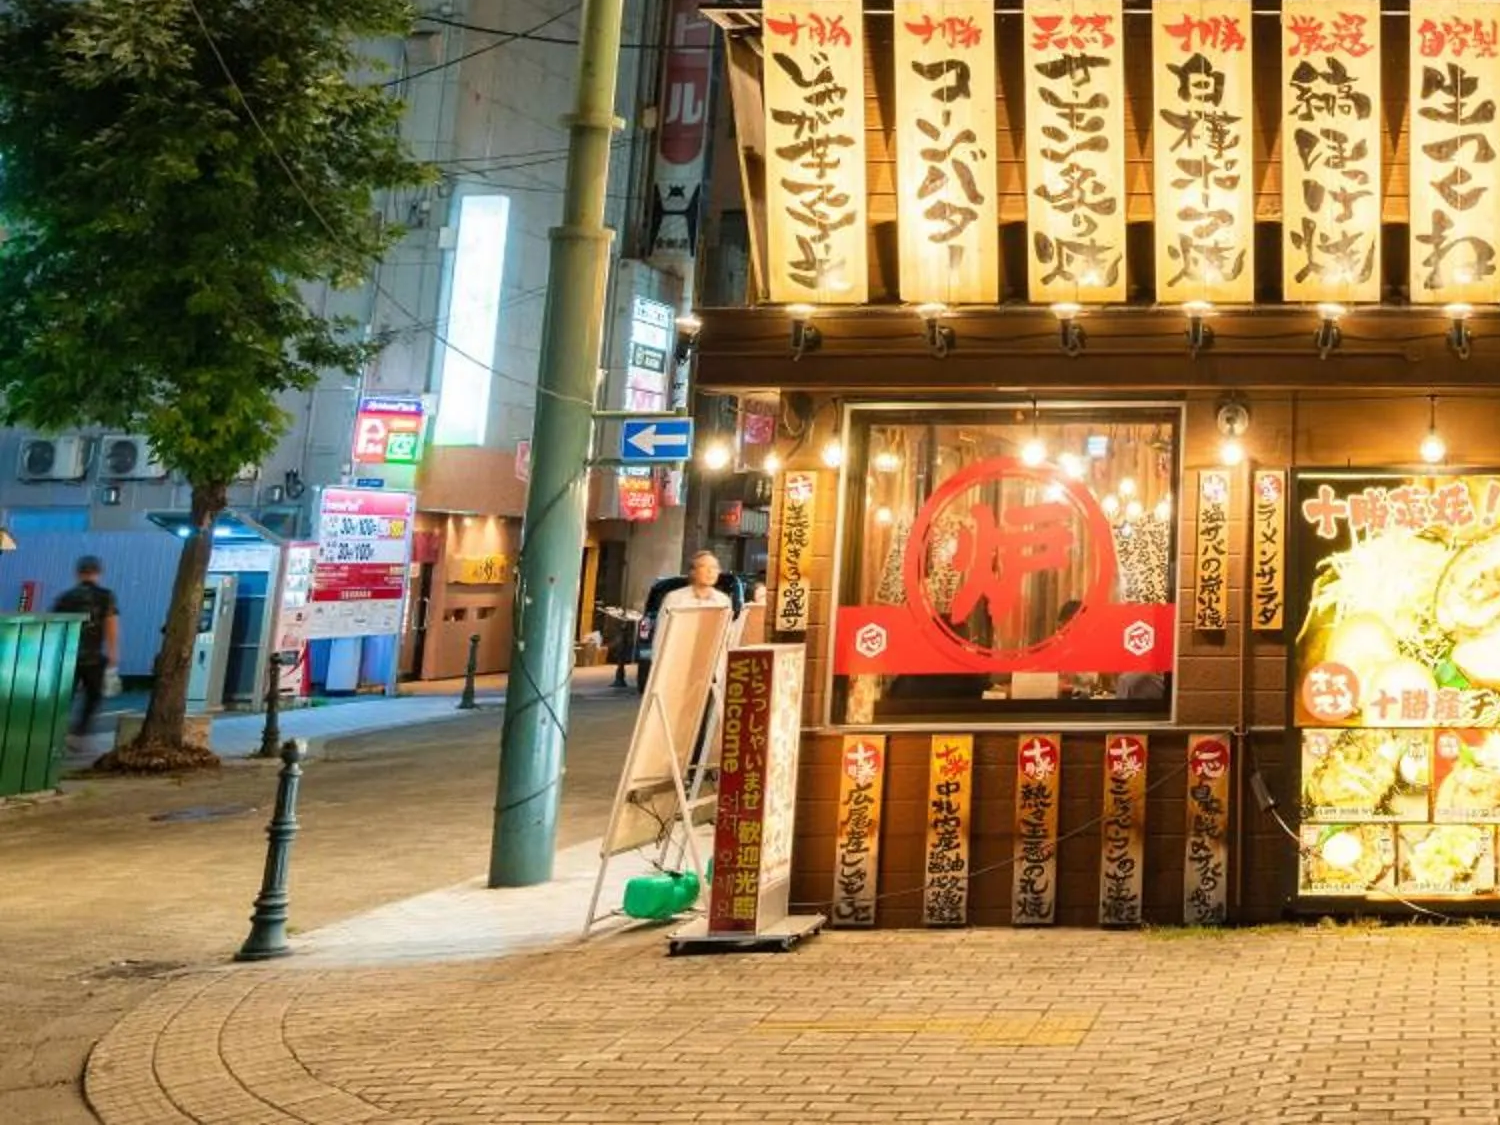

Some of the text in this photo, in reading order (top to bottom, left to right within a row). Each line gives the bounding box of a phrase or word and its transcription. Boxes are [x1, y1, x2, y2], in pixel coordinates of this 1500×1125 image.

[765, 12, 853, 48] 十勝
[904, 14, 983, 49] 十勝
[1162, 13, 1247, 55] 十勝
[1415, 62, 1498, 291] 生つくね
[1255, 502, 1284, 626] ラーメンサラダ
[724, 659, 750, 774] Welcome
